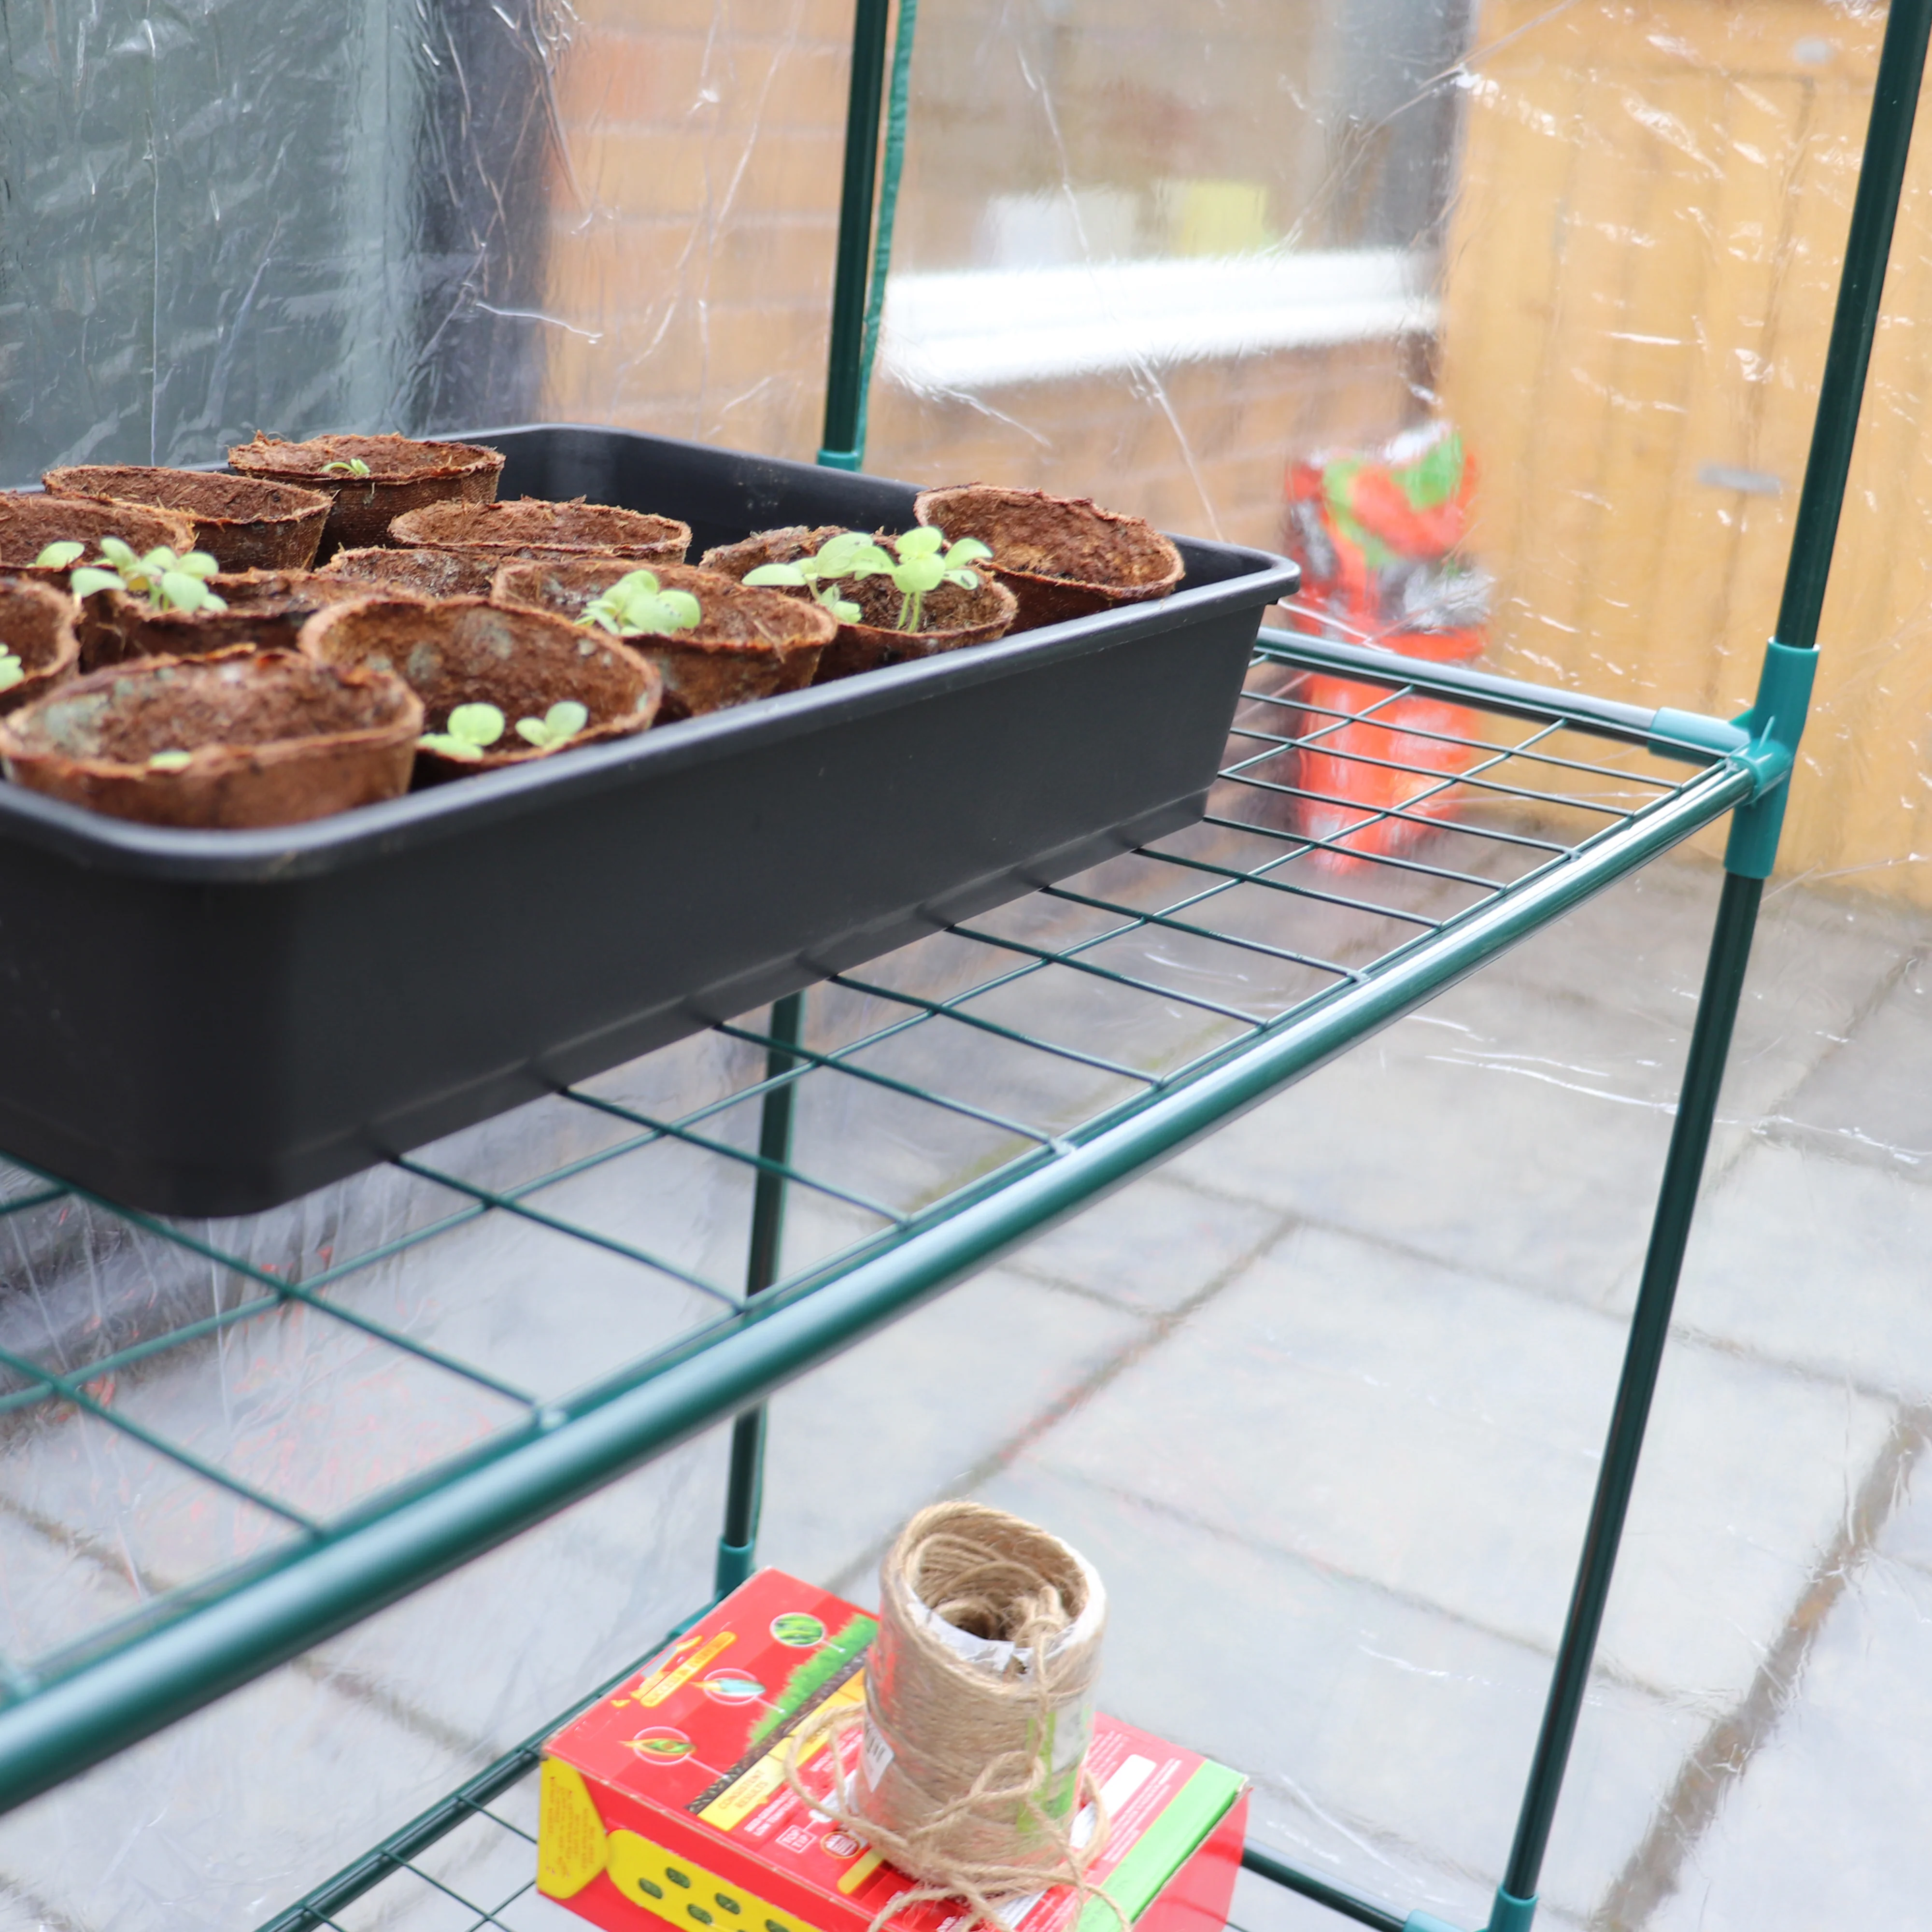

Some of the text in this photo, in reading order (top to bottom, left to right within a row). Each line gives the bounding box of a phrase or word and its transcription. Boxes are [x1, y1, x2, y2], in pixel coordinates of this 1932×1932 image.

[718, 1770, 764, 1809] CONSISTENT
[734, 1781, 769, 1808] RESULTS
[782, 1829, 801, 1844] TOP
[792, 1834, 810, 1848] TIP
